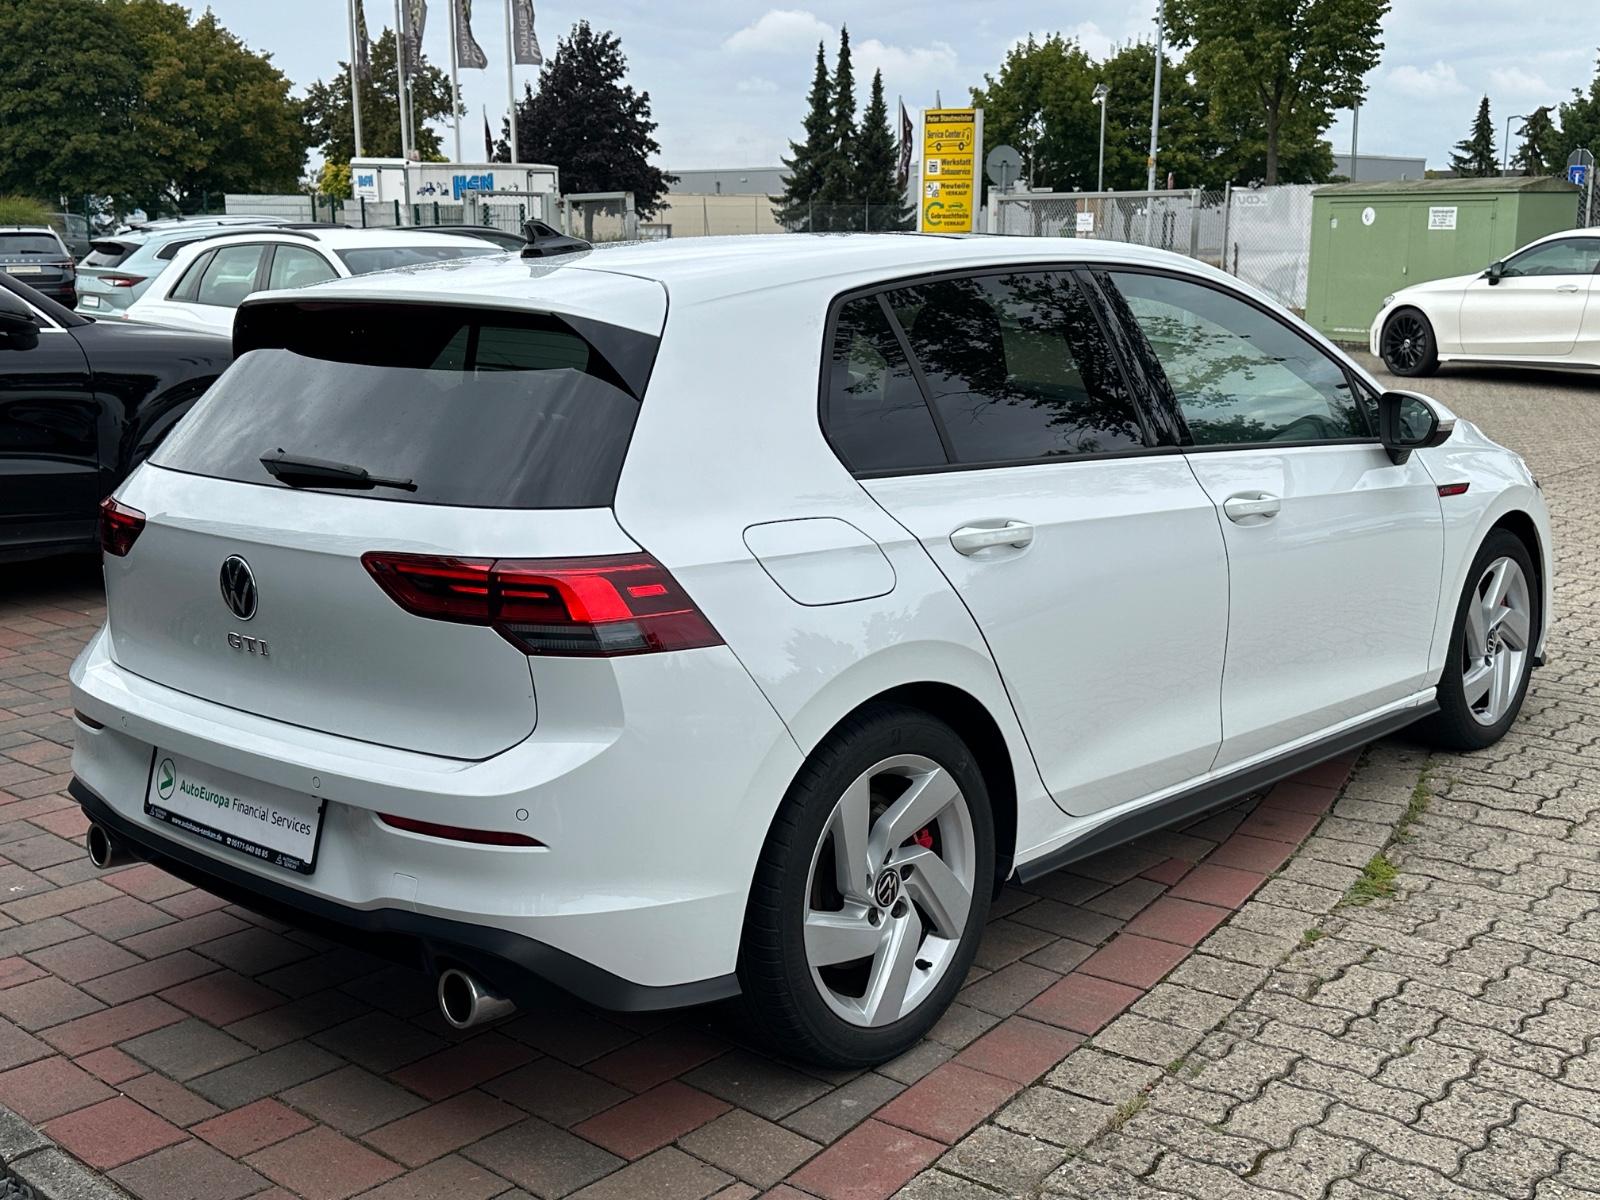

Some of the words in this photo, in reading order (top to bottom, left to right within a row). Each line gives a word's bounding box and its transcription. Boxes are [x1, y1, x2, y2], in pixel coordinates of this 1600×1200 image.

[927, 129, 944, 139] Service
[945, 129, 961, 139] Center
[941, 158, 971, 166] Werkstatt
[941, 182, 970, 190] Neuteile
[227, 631, 269, 656] GTI
[180, 780, 230, 808] AutoEuropa
[232, 797, 268, 822] Financial
[270, 811, 311, 835] Services
